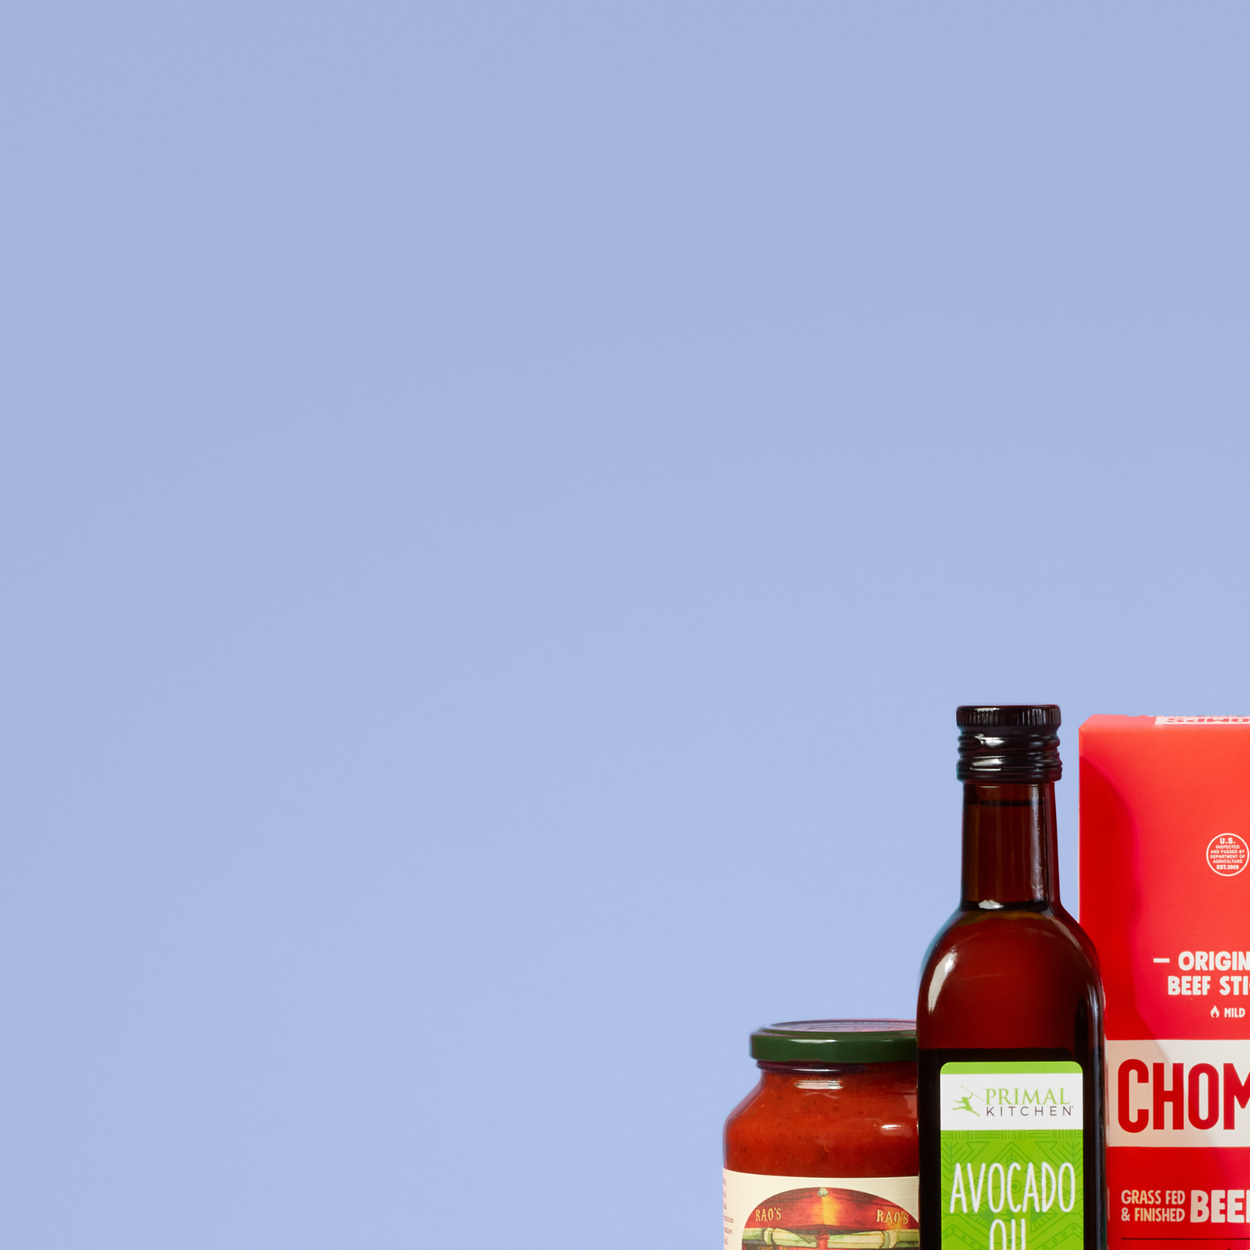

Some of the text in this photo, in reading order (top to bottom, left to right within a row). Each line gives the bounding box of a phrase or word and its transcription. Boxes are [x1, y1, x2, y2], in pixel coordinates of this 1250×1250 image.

[1168, 976, 1211, 996] BEEF
[1224, 1008, 1246, 1018] MILD
[985, 1088, 1070, 1105] PRIMAL
[987, 1107, 1073, 1116] KITCHEN
[950, 1162, 1076, 1213] AVOCADO
[1121, 1189, 1186, 1205] GRASS FED
[755, 1208, 782, 1222] RAO'S
[877, 1209, 909, 1225] RAO'S
[1121, 1207, 1186, 1222] & FINISHED
